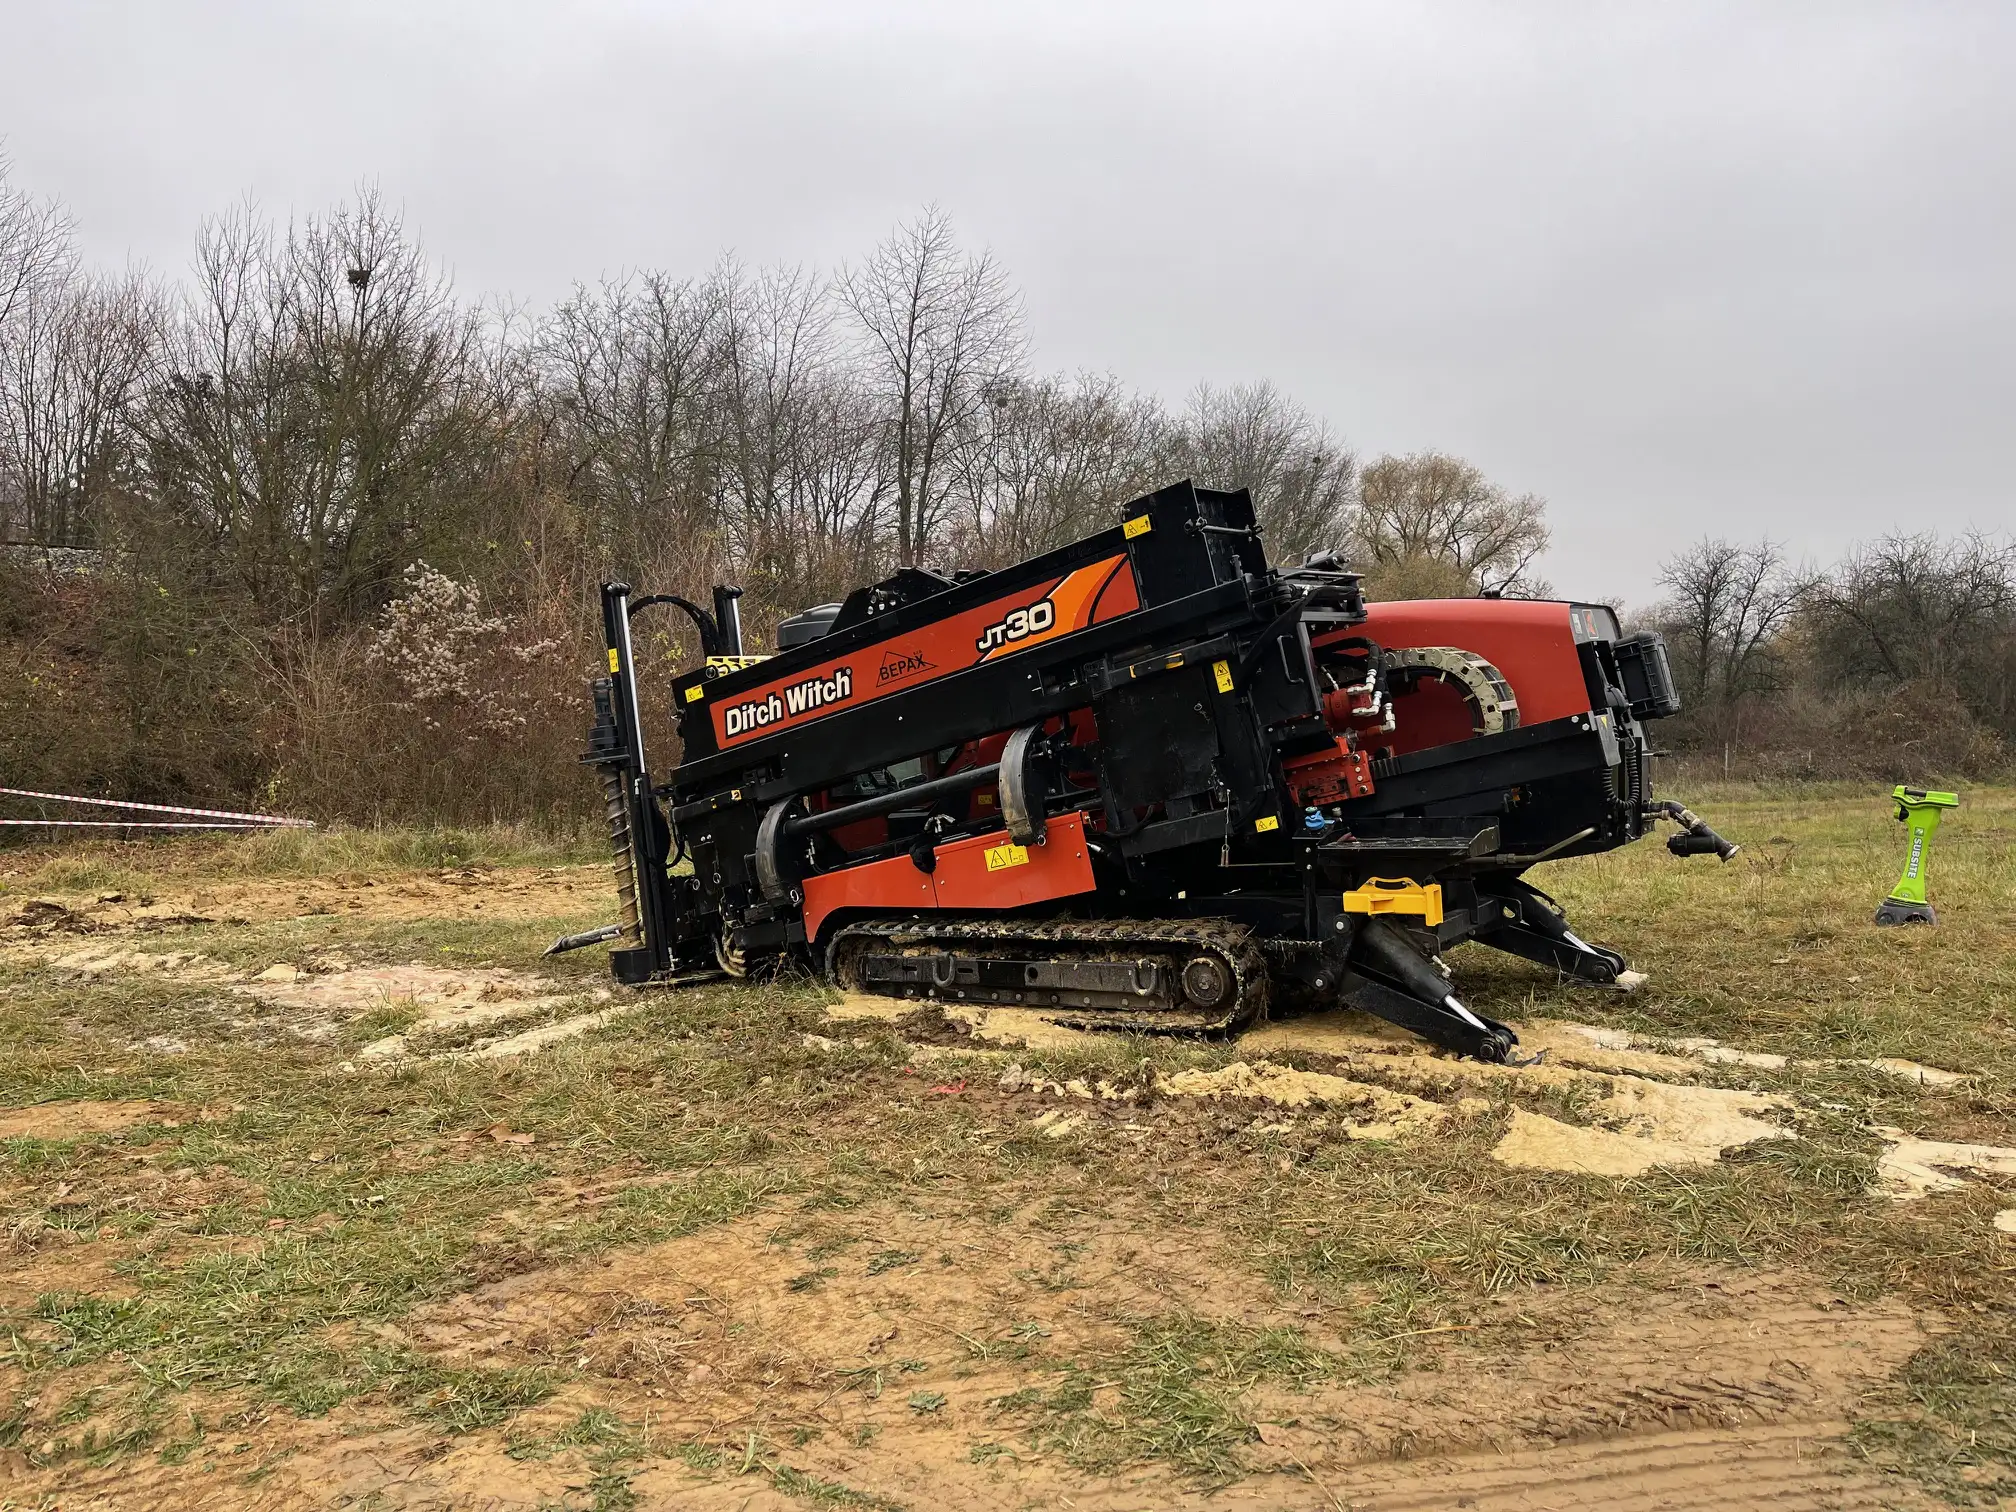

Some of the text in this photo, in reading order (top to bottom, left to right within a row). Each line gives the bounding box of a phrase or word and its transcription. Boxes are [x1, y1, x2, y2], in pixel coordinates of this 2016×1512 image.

[978, 601, 1053, 650] JT30
[879, 653, 926, 680] BEPAX
[726, 671, 850, 736] Ditch Witch
[1907, 837, 1922, 879] SUBSITE
